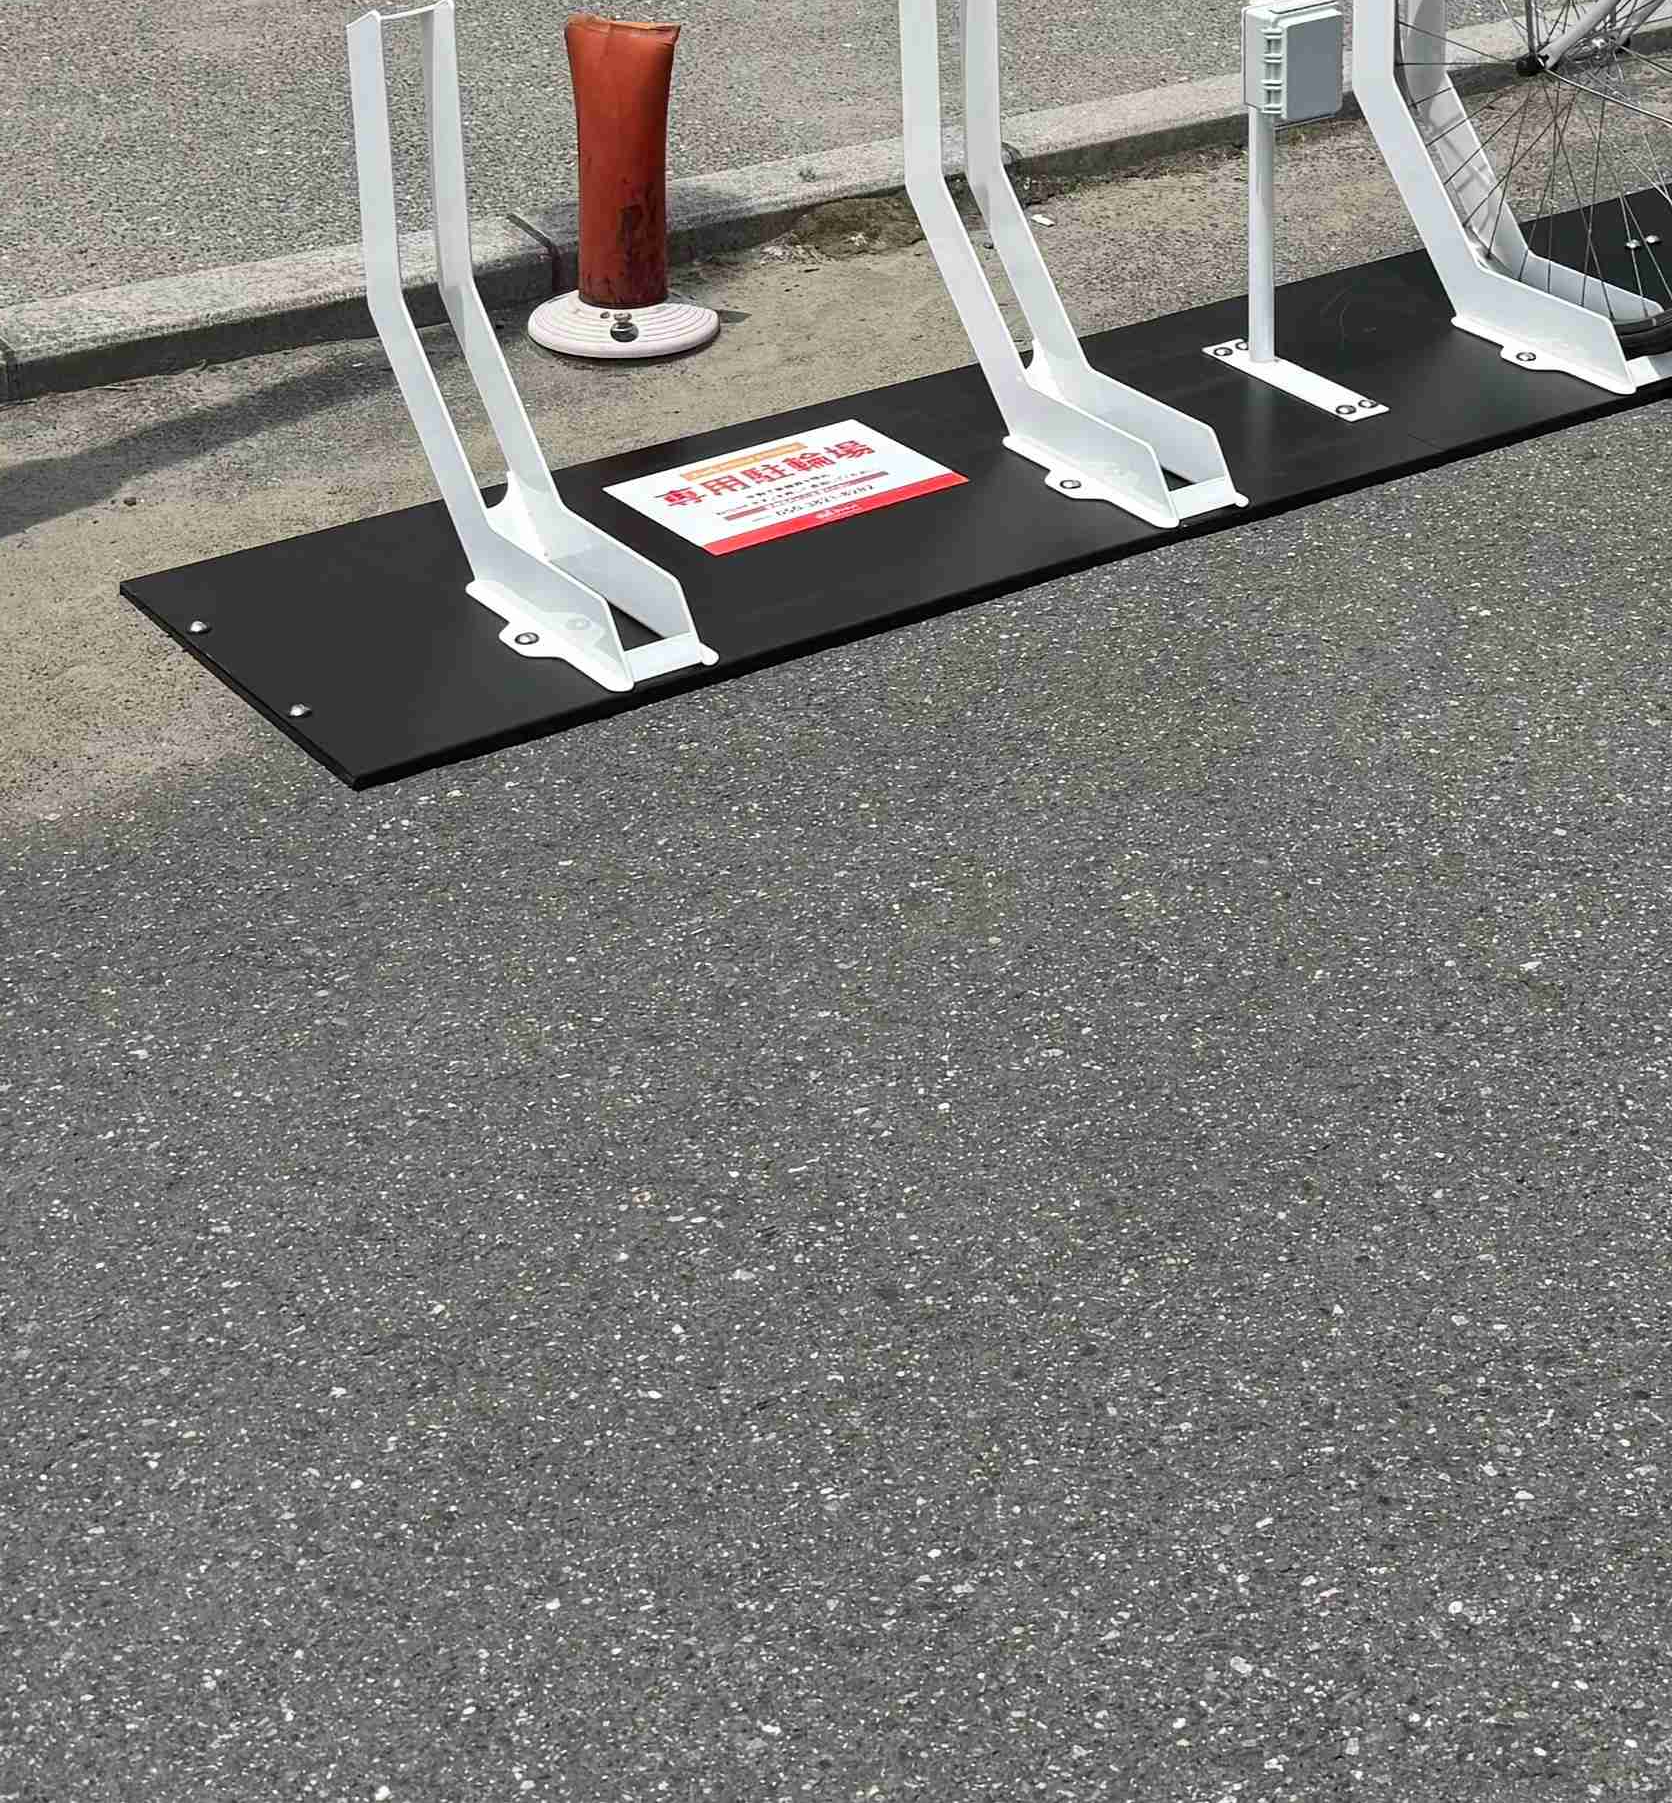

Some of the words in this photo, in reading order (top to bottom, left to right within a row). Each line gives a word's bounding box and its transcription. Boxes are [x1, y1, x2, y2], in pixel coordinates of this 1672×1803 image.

[655, 439, 876, 508] 専用駐輪場
